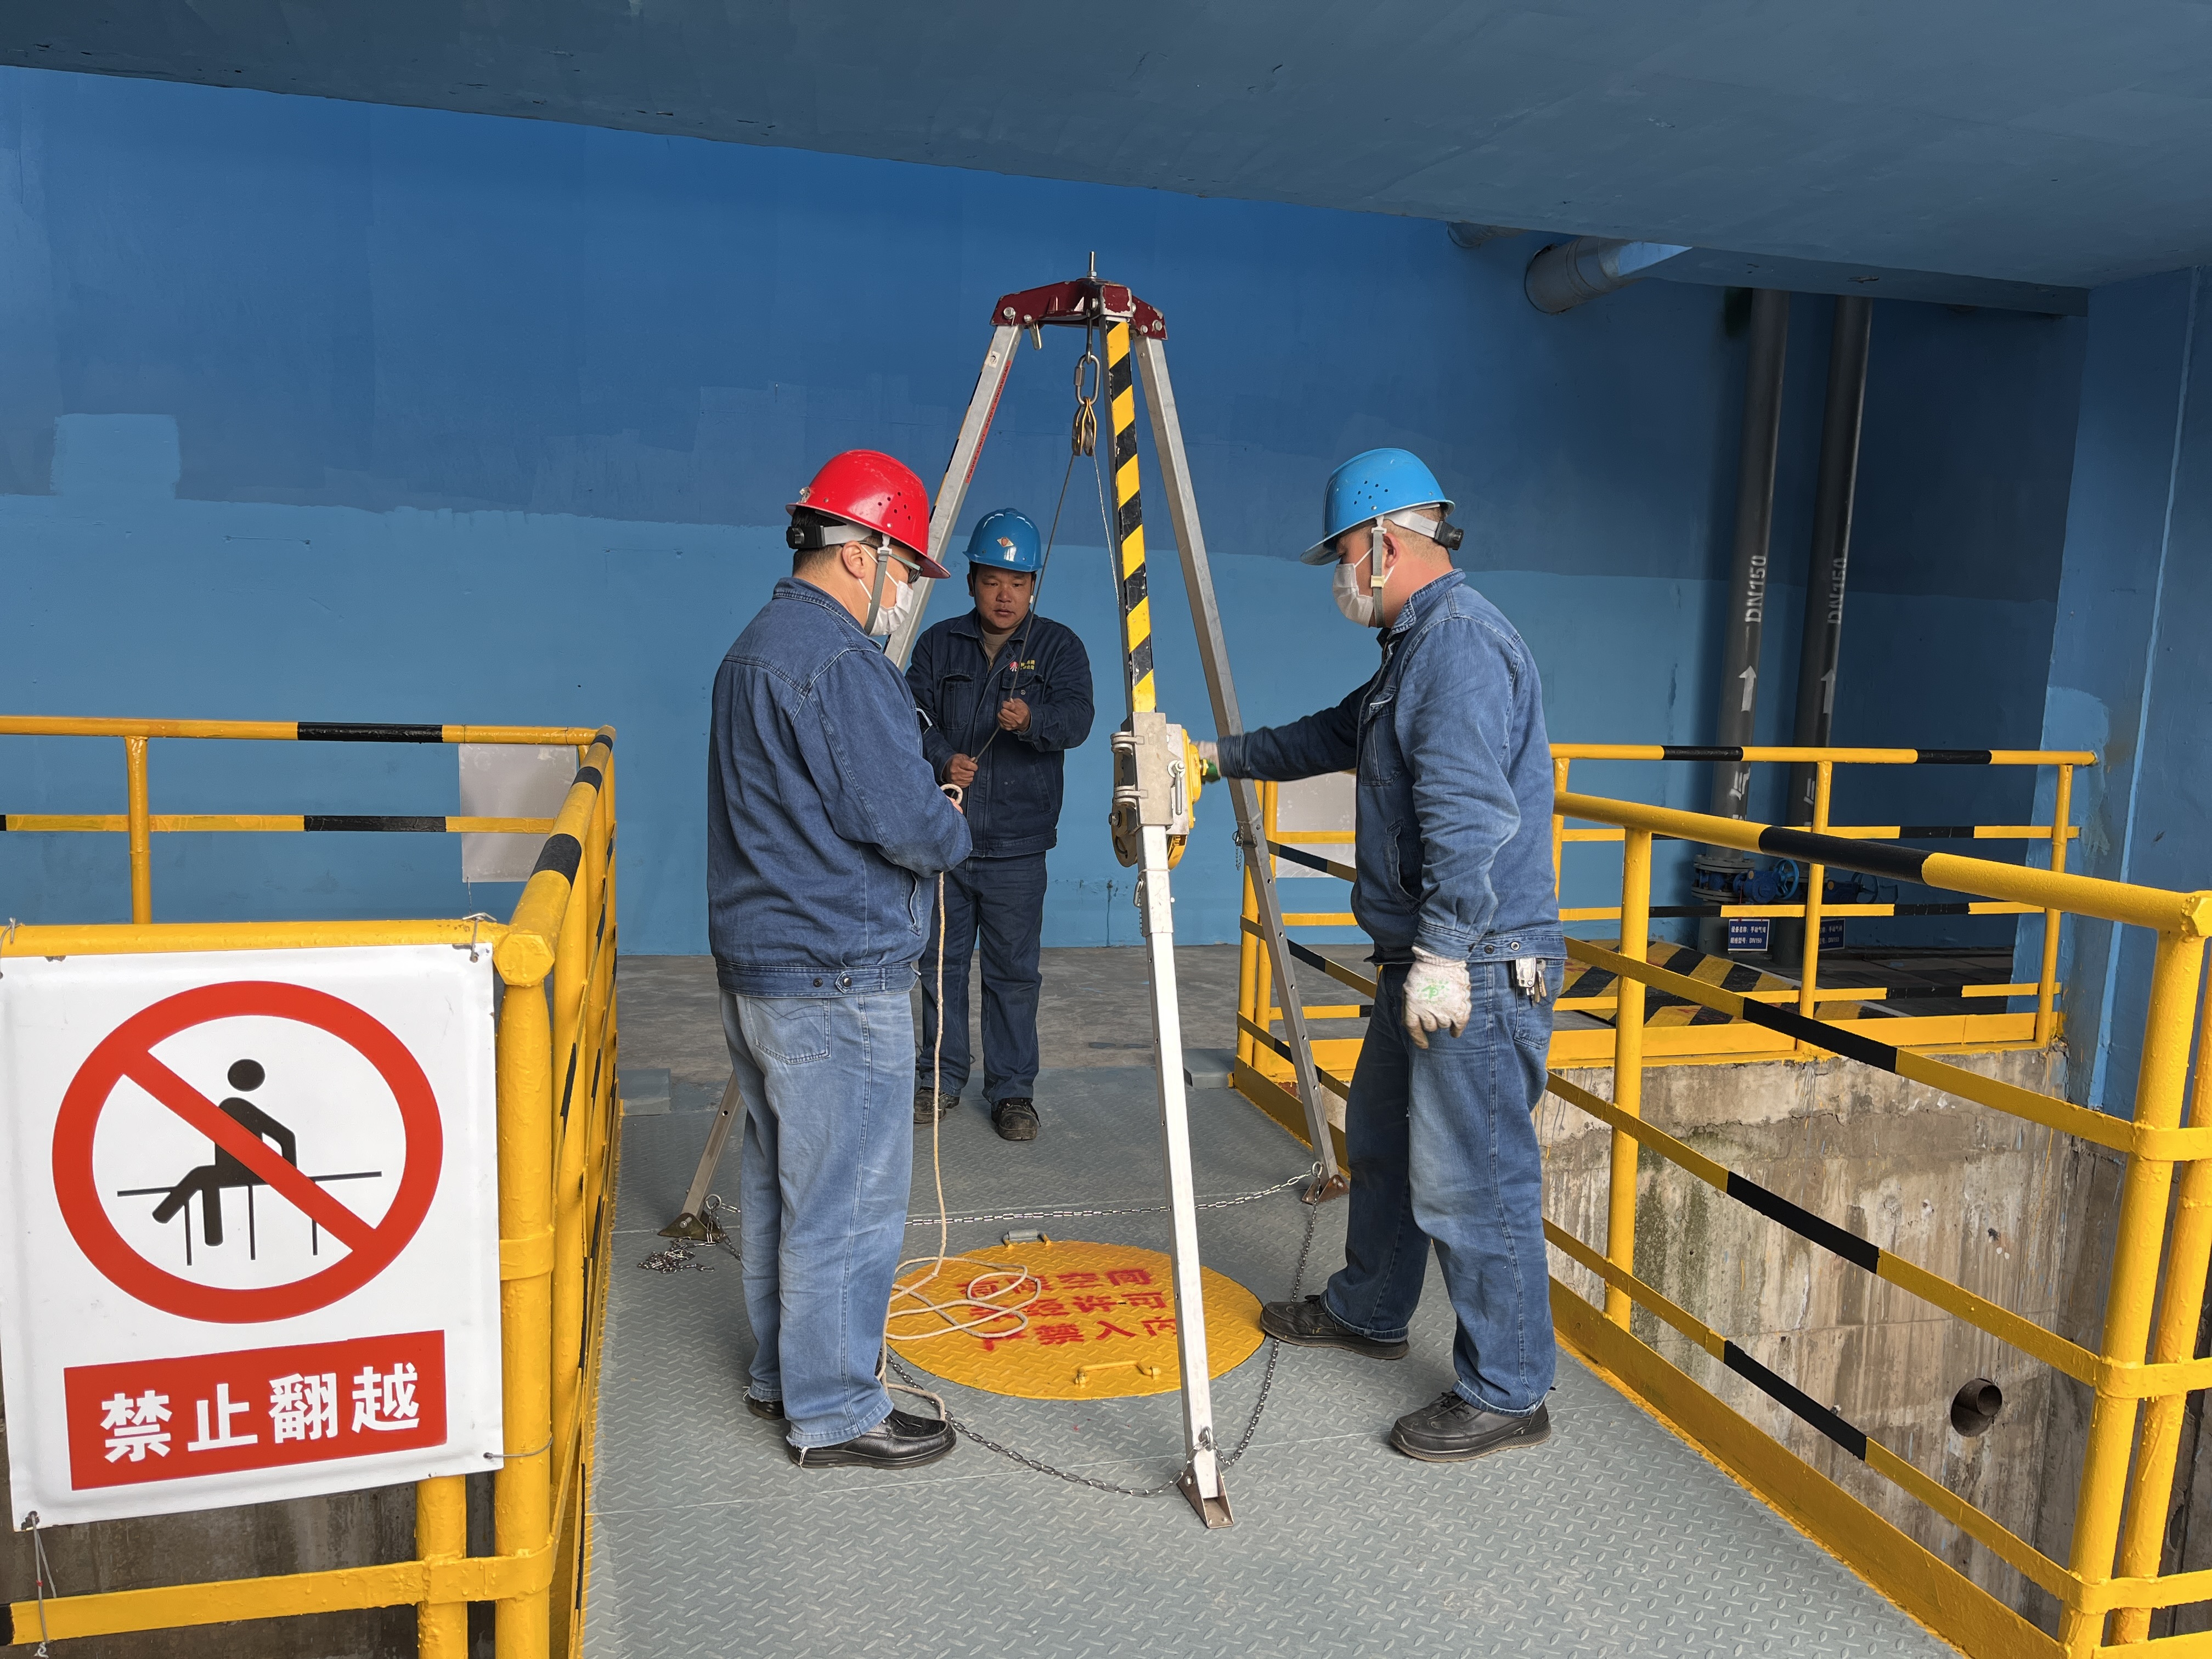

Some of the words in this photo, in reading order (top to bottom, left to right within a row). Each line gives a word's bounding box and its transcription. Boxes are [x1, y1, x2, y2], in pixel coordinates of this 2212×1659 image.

[994, 365, 1009, 403] WORKING
[985, 407, 995, 428] LOAD
[1745, 555, 1766, 623] DN150
[1827, 557, 1847, 624] DN150
[956, 1269, 1152, 1298] 有限空间
[100, 1362, 420, 1463] 禁止翻越
